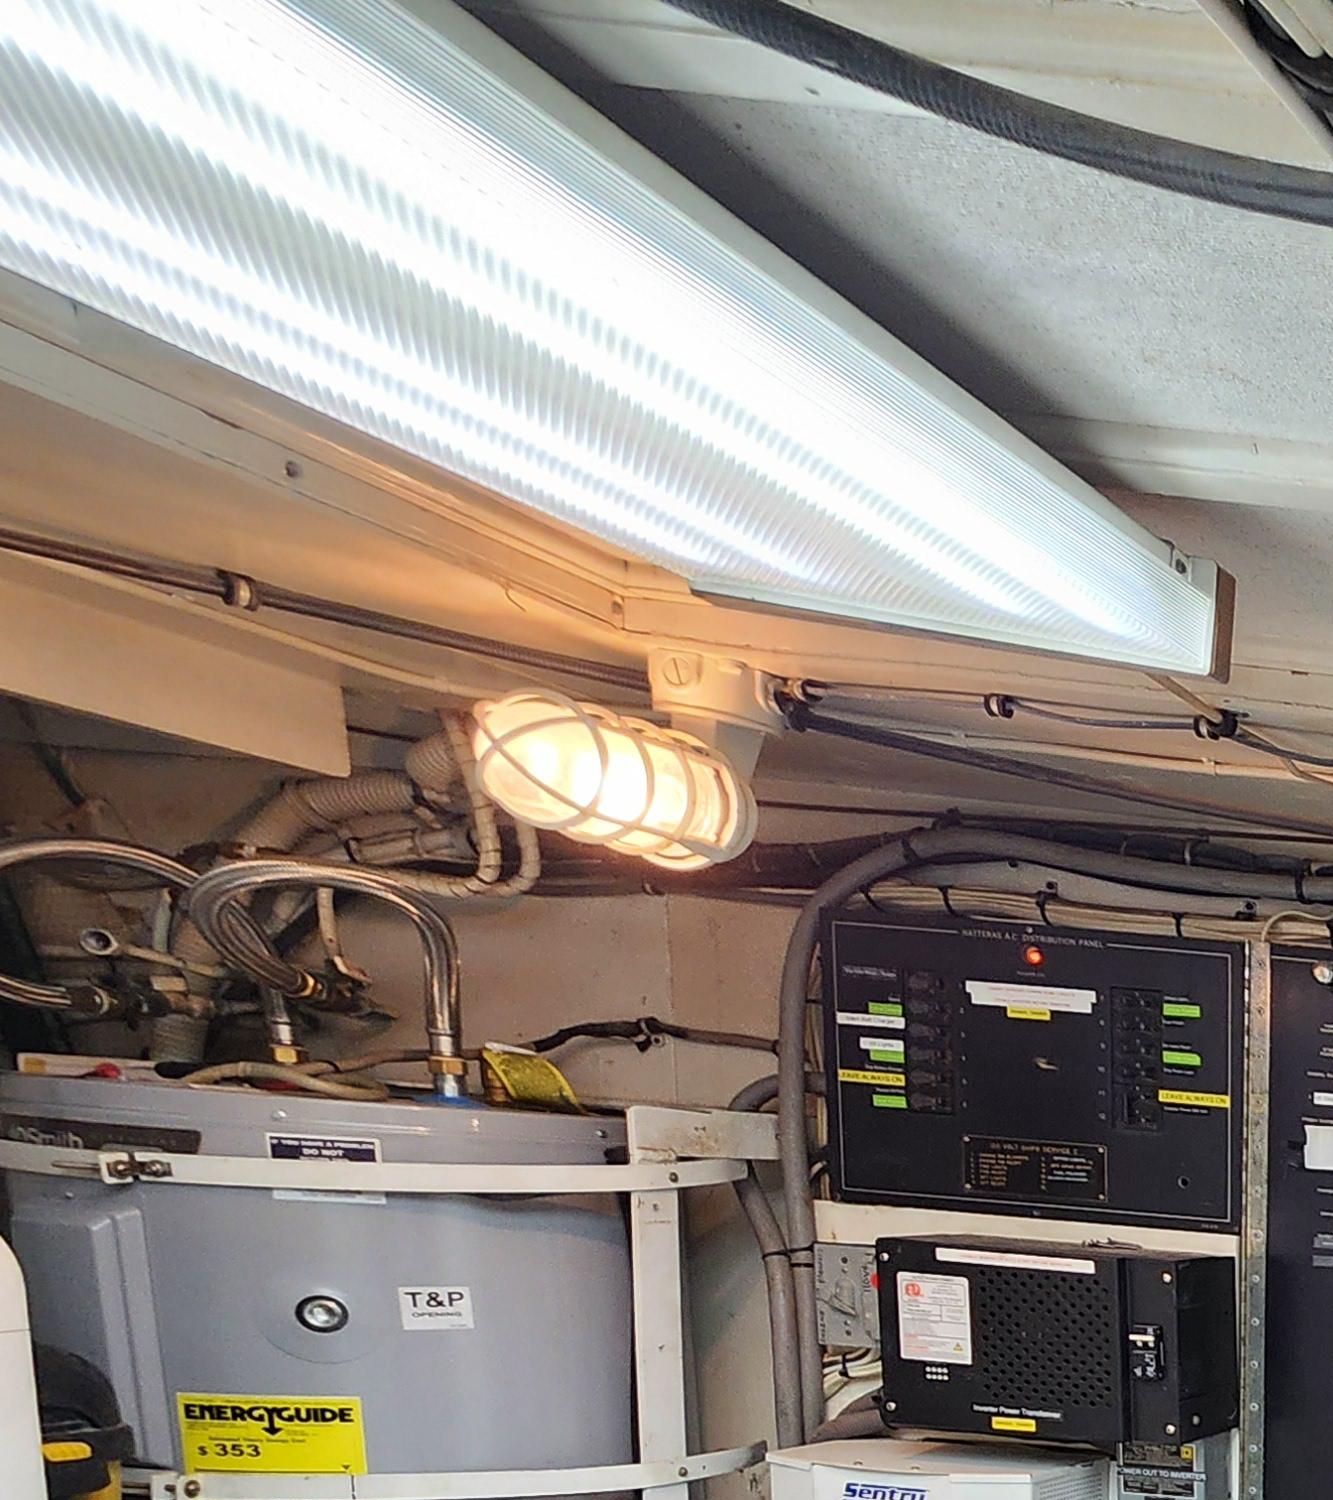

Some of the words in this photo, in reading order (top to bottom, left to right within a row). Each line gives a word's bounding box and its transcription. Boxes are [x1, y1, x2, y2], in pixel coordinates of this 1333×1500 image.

[1022, 934, 1076, 946] DISTRIBUTION
[1078, 939, 1104, 949] PANEL
[841, 1071, 860, 1080] EAVE
[861, 1073, 890, 1083] ALWAYS
[890, 1075, 903, 1084] ON
[1161, 1092, 1184, 1101] LEAVE
[1186, 1094, 1213, 1103] ALWAYS
[1215, 1097, 1228, 1105] ON
[302, 1148, 319, 1156] DO
[320, 1148, 345, 1157] NOT
[403, 1291, 465, 1308] T&P
[183, 1402, 355, 1424] ENERGYGUIDE
[972, 1403, 999, 1413] Inverter
[999, 1405, 1020, 1415] Power
[1020, 1407, 1061, 1419] Transformer
[214, 1442, 261, 1458] 353
[1142, 1468, 1158, 1476] OUT
[1159, 1470, 1170, 1478] TO
[1170, 1471, 1207, 1481] INVERTER
